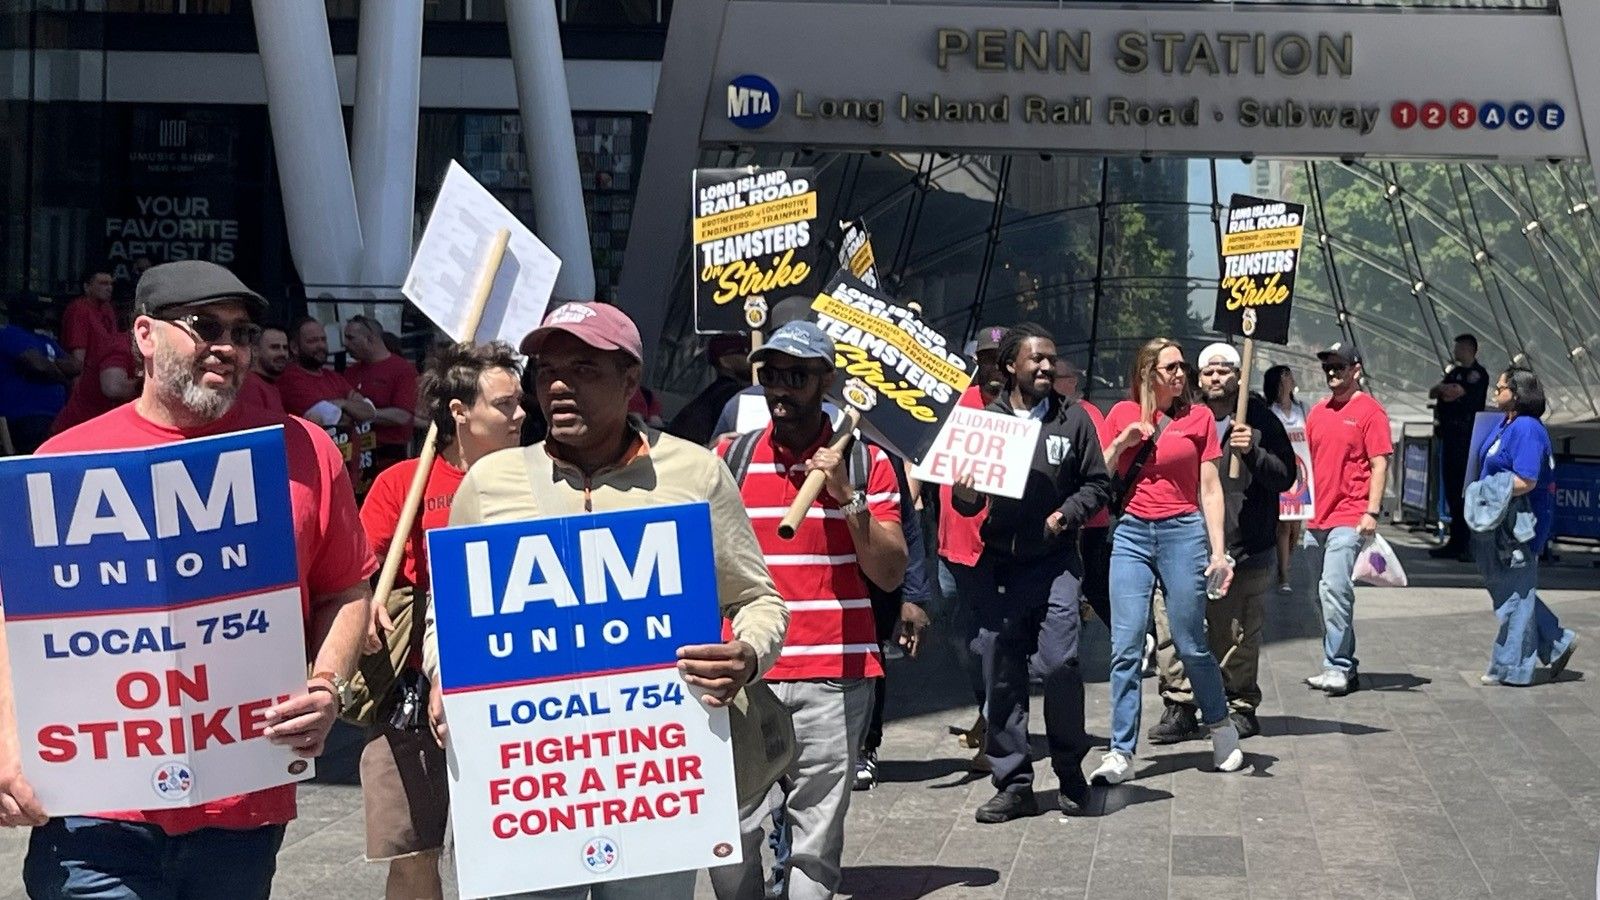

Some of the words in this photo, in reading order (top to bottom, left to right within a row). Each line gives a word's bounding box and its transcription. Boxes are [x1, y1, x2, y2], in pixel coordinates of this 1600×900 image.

[936, 28, 1091, 73] PENN
[1115, 31, 1353, 76] STATION
[727, 84, 772, 118] MTA
[794, 89, 884, 125] Long
[899, 92, 1010, 122] Island
[1024, 93, 1092, 126] Rail
[1107, 95, 1200, 127] Road
[1238, 97, 1380, 136] Subway
[136, 195, 210, 217] YOUR
[700, 181, 736, 202] LONG
[736, 170, 788, 194] ISLAND
[700, 193, 746, 217] RAIL
[749, 178, 809, 206] ROAD
[105, 218, 238, 240] FAVORITE
[701, 221, 750, 238] ENGINEERS
[762, 208, 809, 224] TRAINMEN
[1229, 219, 1256, 233] RAIL
[1257, 213, 1300, 230] ROAD
[1252, 203, 1287, 218] ISLAND
[108, 240, 204, 262] ARTIST
[211, 241, 235, 262] IS
[701, 220, 811, 267] TEAMSTERS
[1225, 250, 1295, 278] TEAMSTERS
[713, 248, 812, 305] Strike
[1226, 272, 1290, 311] Strike
[836, 282, 886, 310] LONG
[887, 303, 947, 348] ISLAND
[816, 312, 954, 404] TEAMSTERS
[824, 305, 891, 338] ENGINEERS
[904, 344, 959, 385] TRAINMEN
[898, 318, 967, 371] ROAD
[946, 427, 1006, 460] FOR
[950, 411, 1032, 437] LIDARITY
[930, 452, 1007, 488] EVER
[26, 448, 258, 548] IAM
[1556, 488, 1590, 508] ENN
[54, 544, 248, 588] UNION
[464, 520, 683, 618] IAM
[43, 626, 187, 659] LOCAL
[196, 608, 270, 645] 754
[488, 614, 672, 658] UNION
[116, 664, 210, 710] ON
[488, 691, 611, 728] LOCAL
[620, 681, 685, 712] 754
[37, 694, 290, 763] STRIKE
[500, 722, 687, 770] FIGHTING
[489, 772, 567, 806] FOR
[578, 767, 606, 795] A
[616, 754, 703, 790] FAIR
[491, 789, 706, 840] CONTRACT
